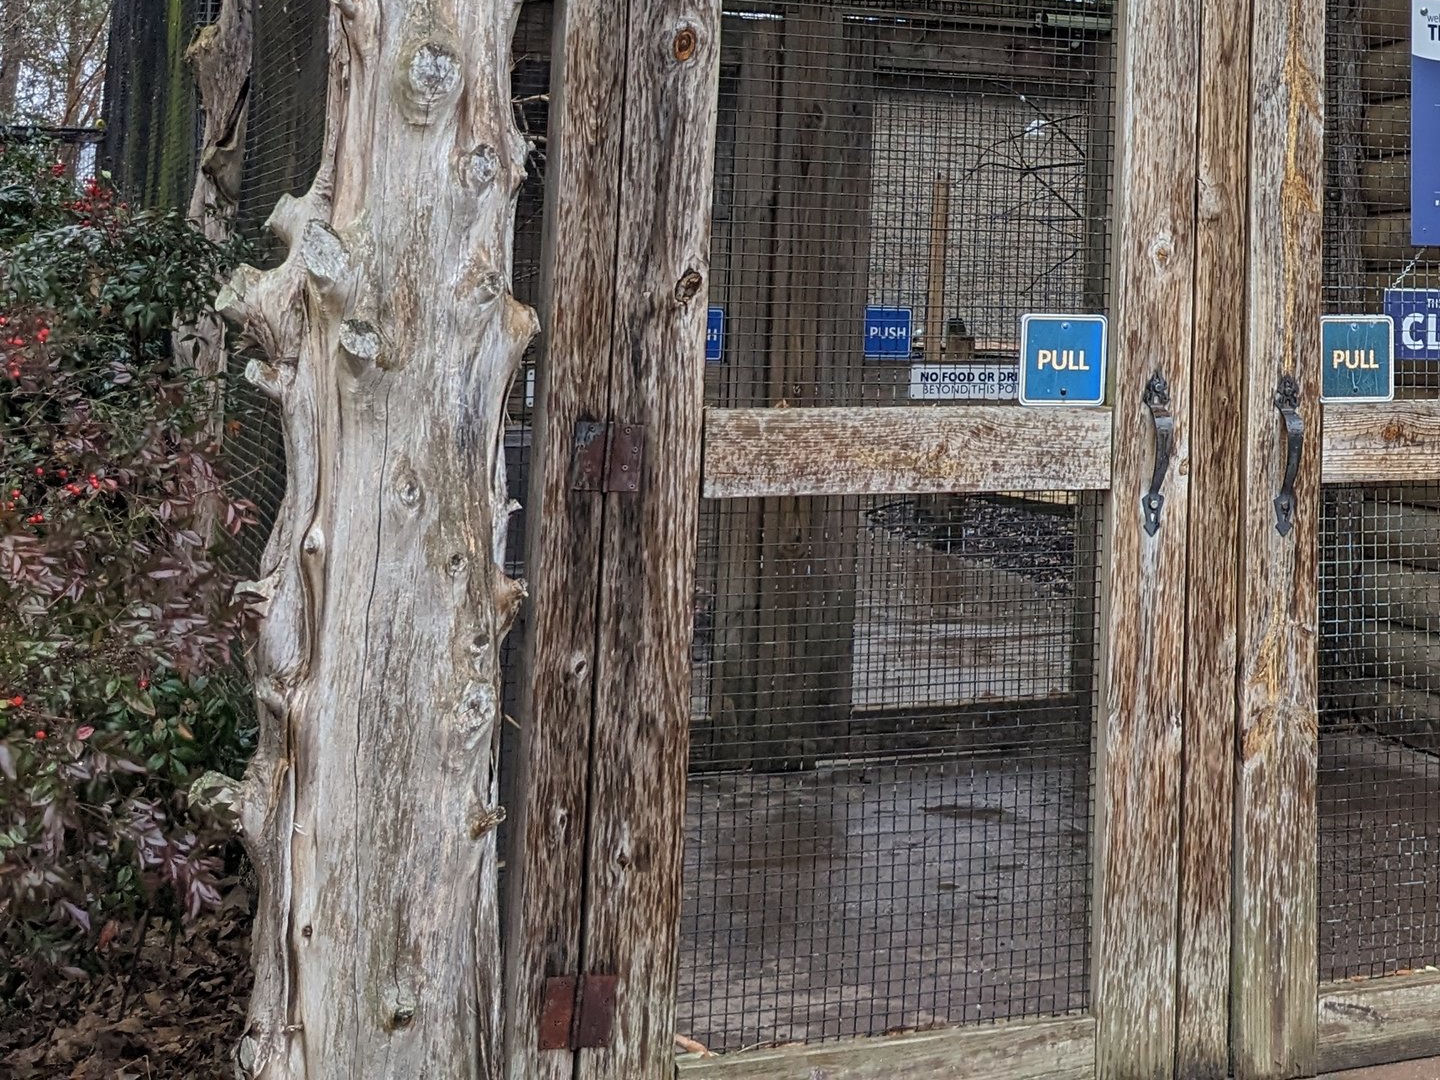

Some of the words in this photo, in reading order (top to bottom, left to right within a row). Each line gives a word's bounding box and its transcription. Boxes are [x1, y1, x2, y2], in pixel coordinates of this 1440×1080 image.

[869, 326, 906, 339] PUSH
[1038, 349, 1090, 370] PULL
[1333, 349, 1379, 369] PULL
[920, 372, 939, 382] NO
[942, 372, 975, 382] FOOD
[978, 372, 995, 382] OR
[998, 372, 1018, 382] DRI
[923, 385, 968, 394] BEYOND
[971, 385, 995, 394] THIS
[998, 385, 1017, 394] POI
